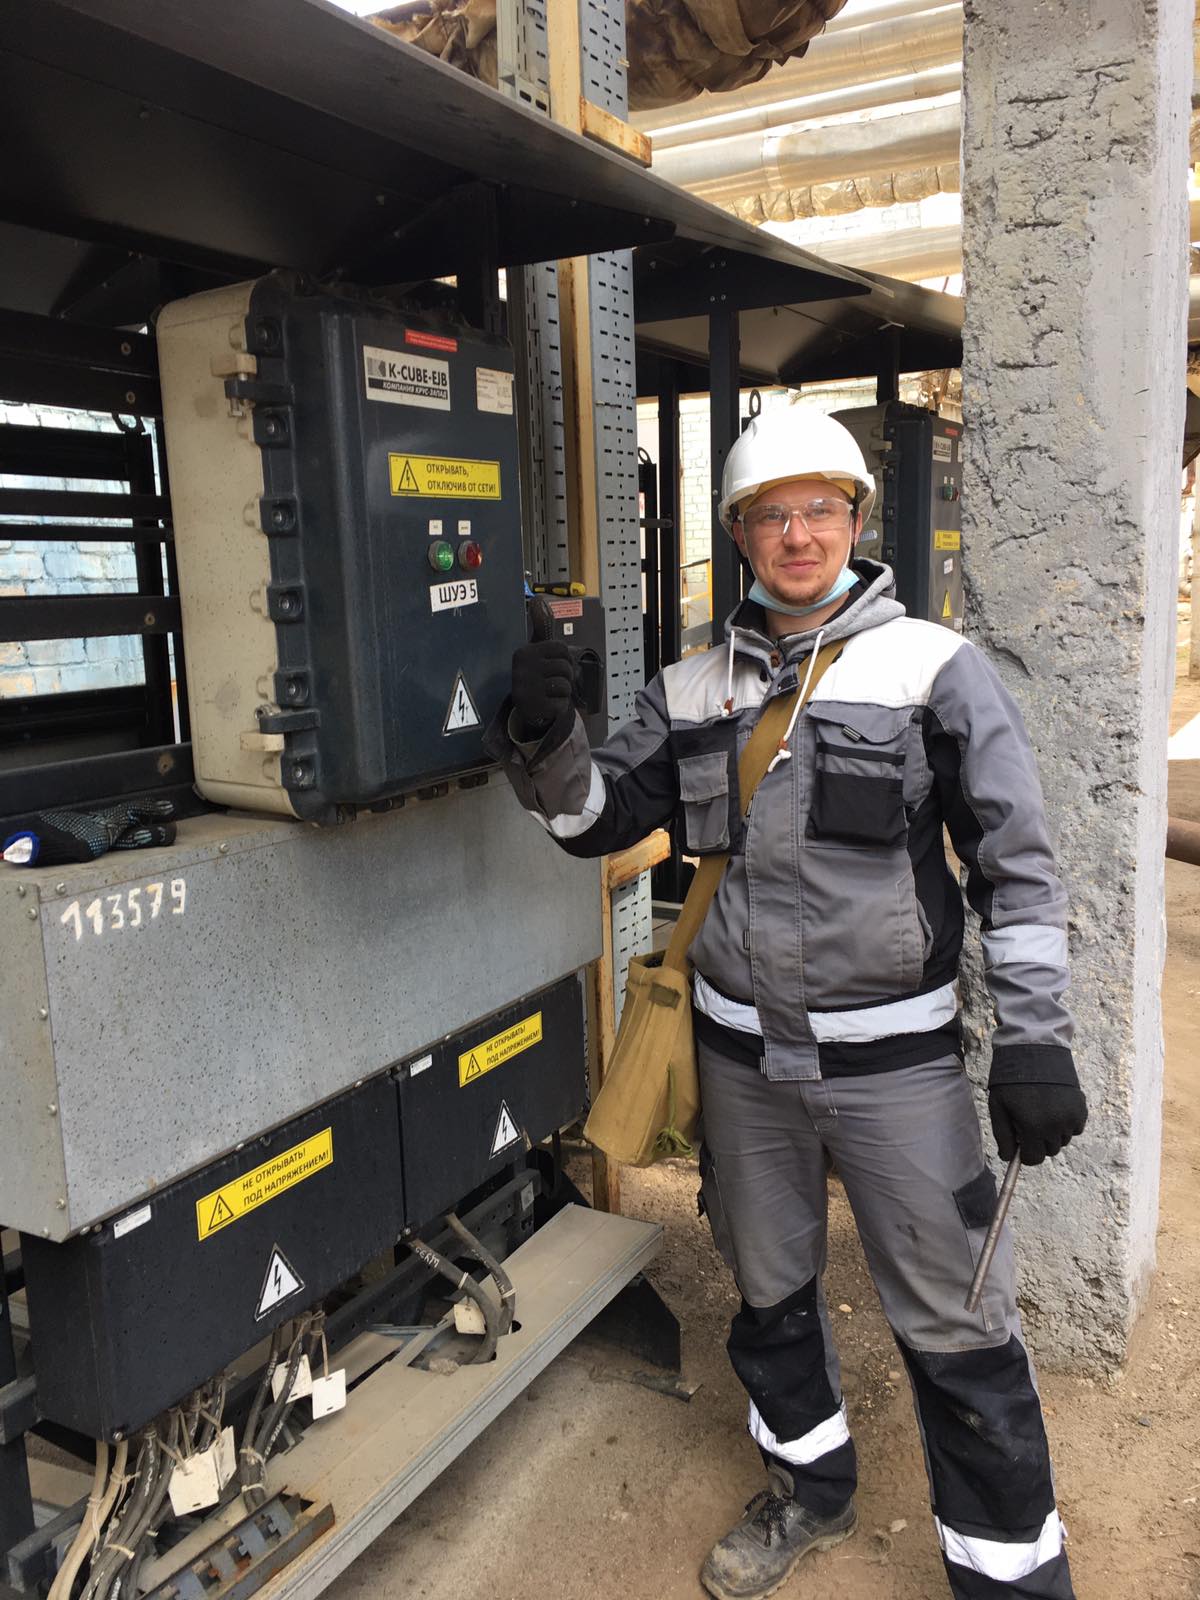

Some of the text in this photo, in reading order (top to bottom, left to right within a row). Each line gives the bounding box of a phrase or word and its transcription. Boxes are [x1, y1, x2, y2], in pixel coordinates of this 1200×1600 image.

[382, 381, 414, 393] КОМПАНИЯ
[388, 362, 448, 387] K-CUBE-EJB
[426, 463, 470, 477] ОТКРЫВАТЬ,
[427, 480, 497, 494] ОТКЛЮЧИВ ОТ СЕТИ!
[439, 582, 477, 603] ШУЭ 5
[60, 878, 186, 941] 113579
[486, 1025, 526, 1053] НЕ ОТКРЫВАТЬ!
[486, 1029, 540, 1065] ПОД НАПРЯЖЕНИЕМ!
[242, 1148, 306, 1191] НЕ ОТКРЫВАТЬ!
[243, 1150, 329, 1207] ПОД НАПРЯЖЕНИЕМ!
